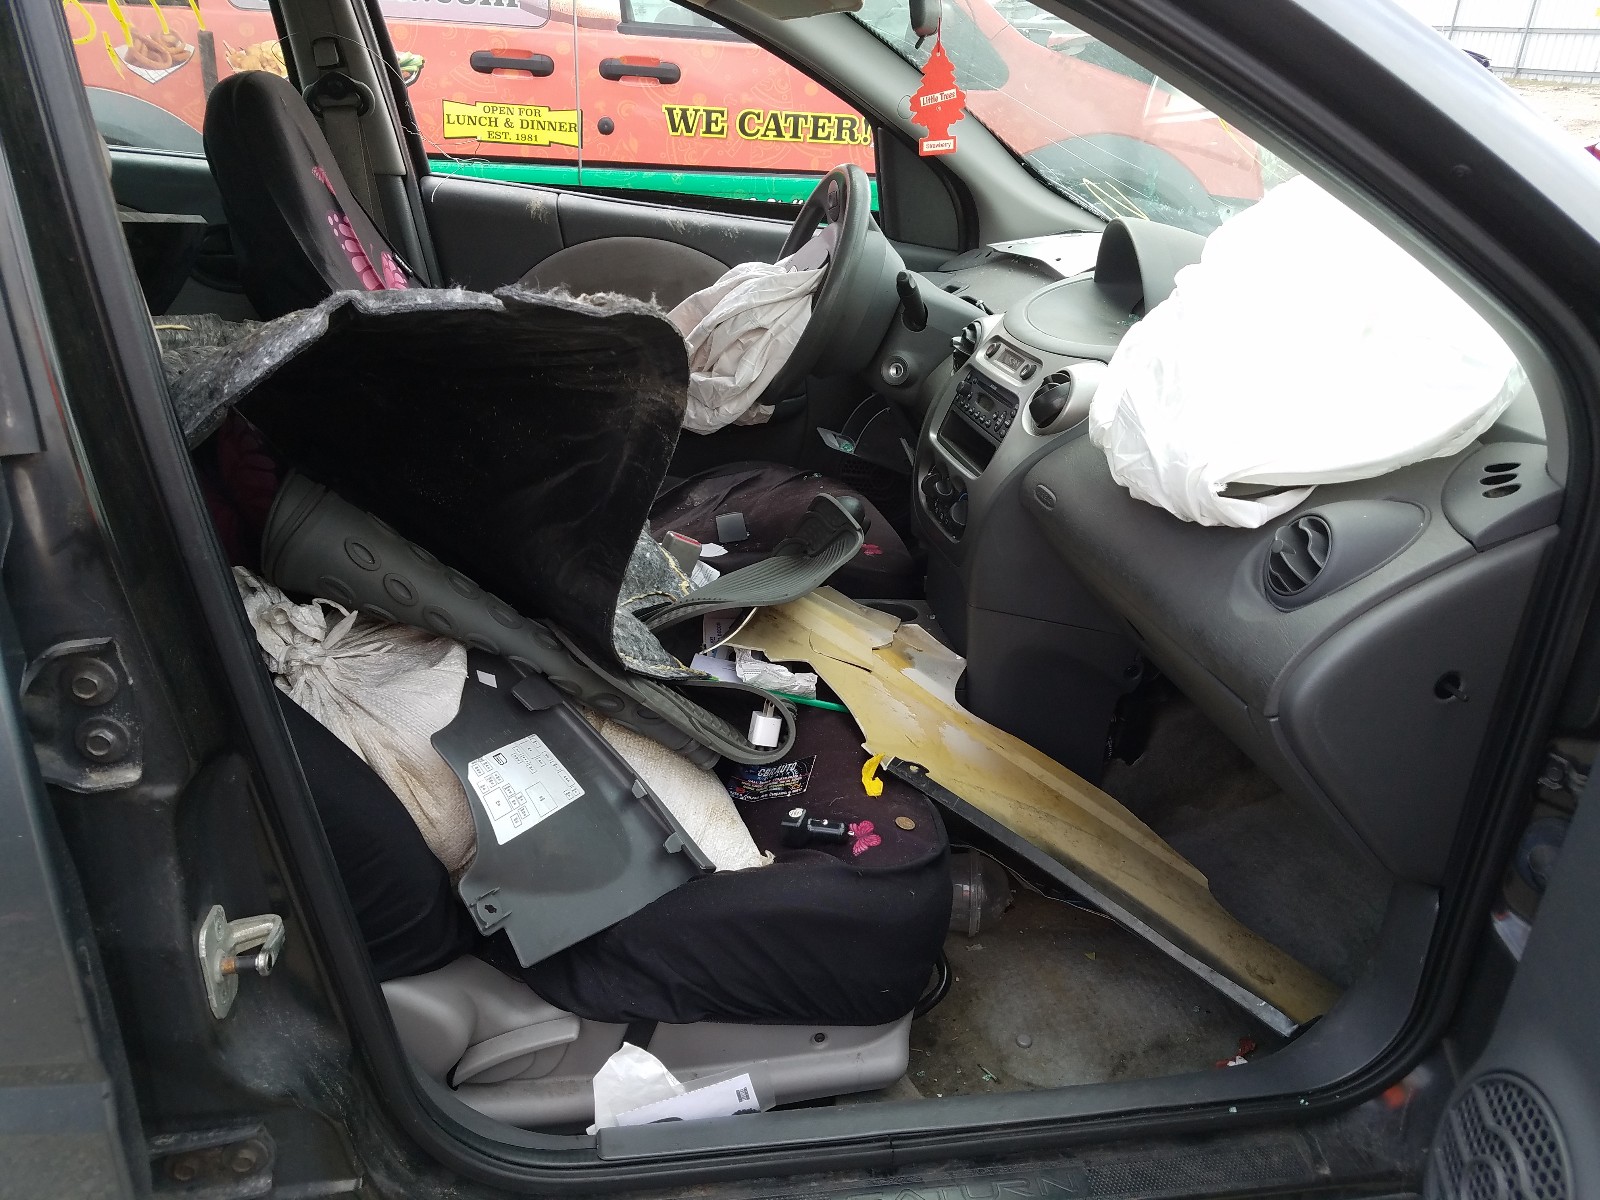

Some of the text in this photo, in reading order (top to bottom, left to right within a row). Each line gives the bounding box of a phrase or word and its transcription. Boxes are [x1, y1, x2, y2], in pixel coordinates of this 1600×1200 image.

[922, 91, 956, 106] Little Trees
[482, 105, 542, 118] OPEN FOR
[445, 113, 578, 133] LUNCH & DINNER
[663, 105, 873, 144] WE CATER!
[487, 130, 539, 142] EST. 1981
